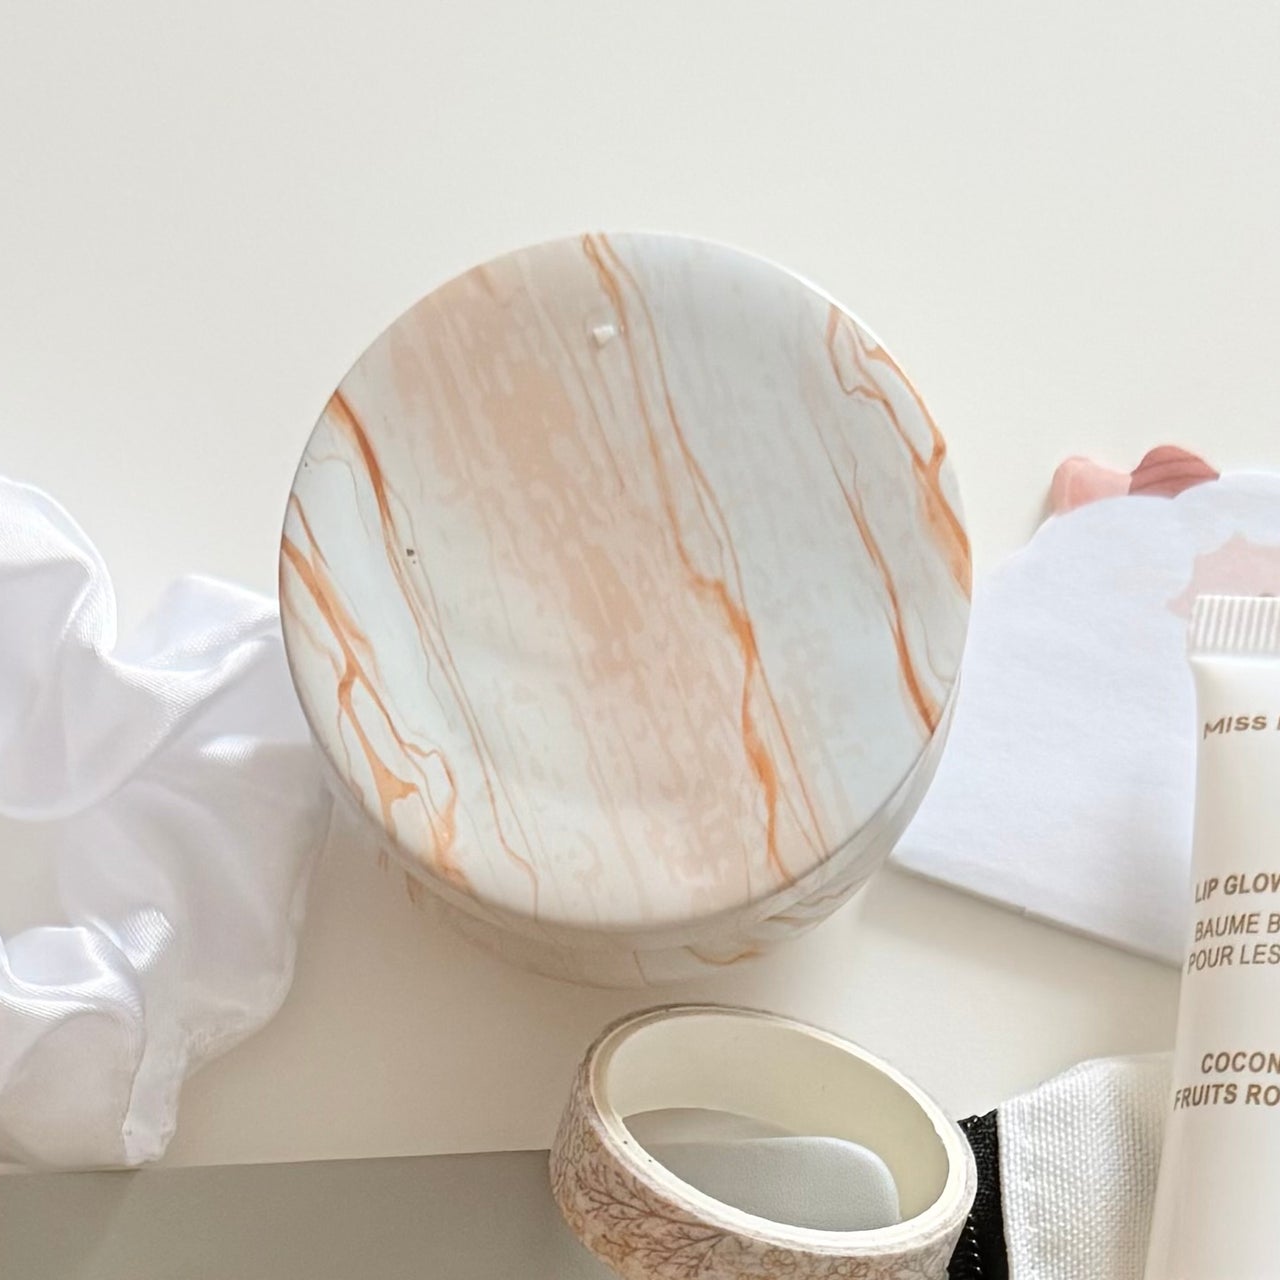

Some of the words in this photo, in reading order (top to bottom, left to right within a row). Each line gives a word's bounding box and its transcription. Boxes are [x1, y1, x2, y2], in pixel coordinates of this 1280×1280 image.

[1203, 714, 1268, 741] MISS
[1194, 877, 1219, 905] LIP
[1194, 912, 1260, 943] BAUME
[1187, 945, 1234, 976] POUR
[1173, 1083, 1238, 1112] FRUITS
